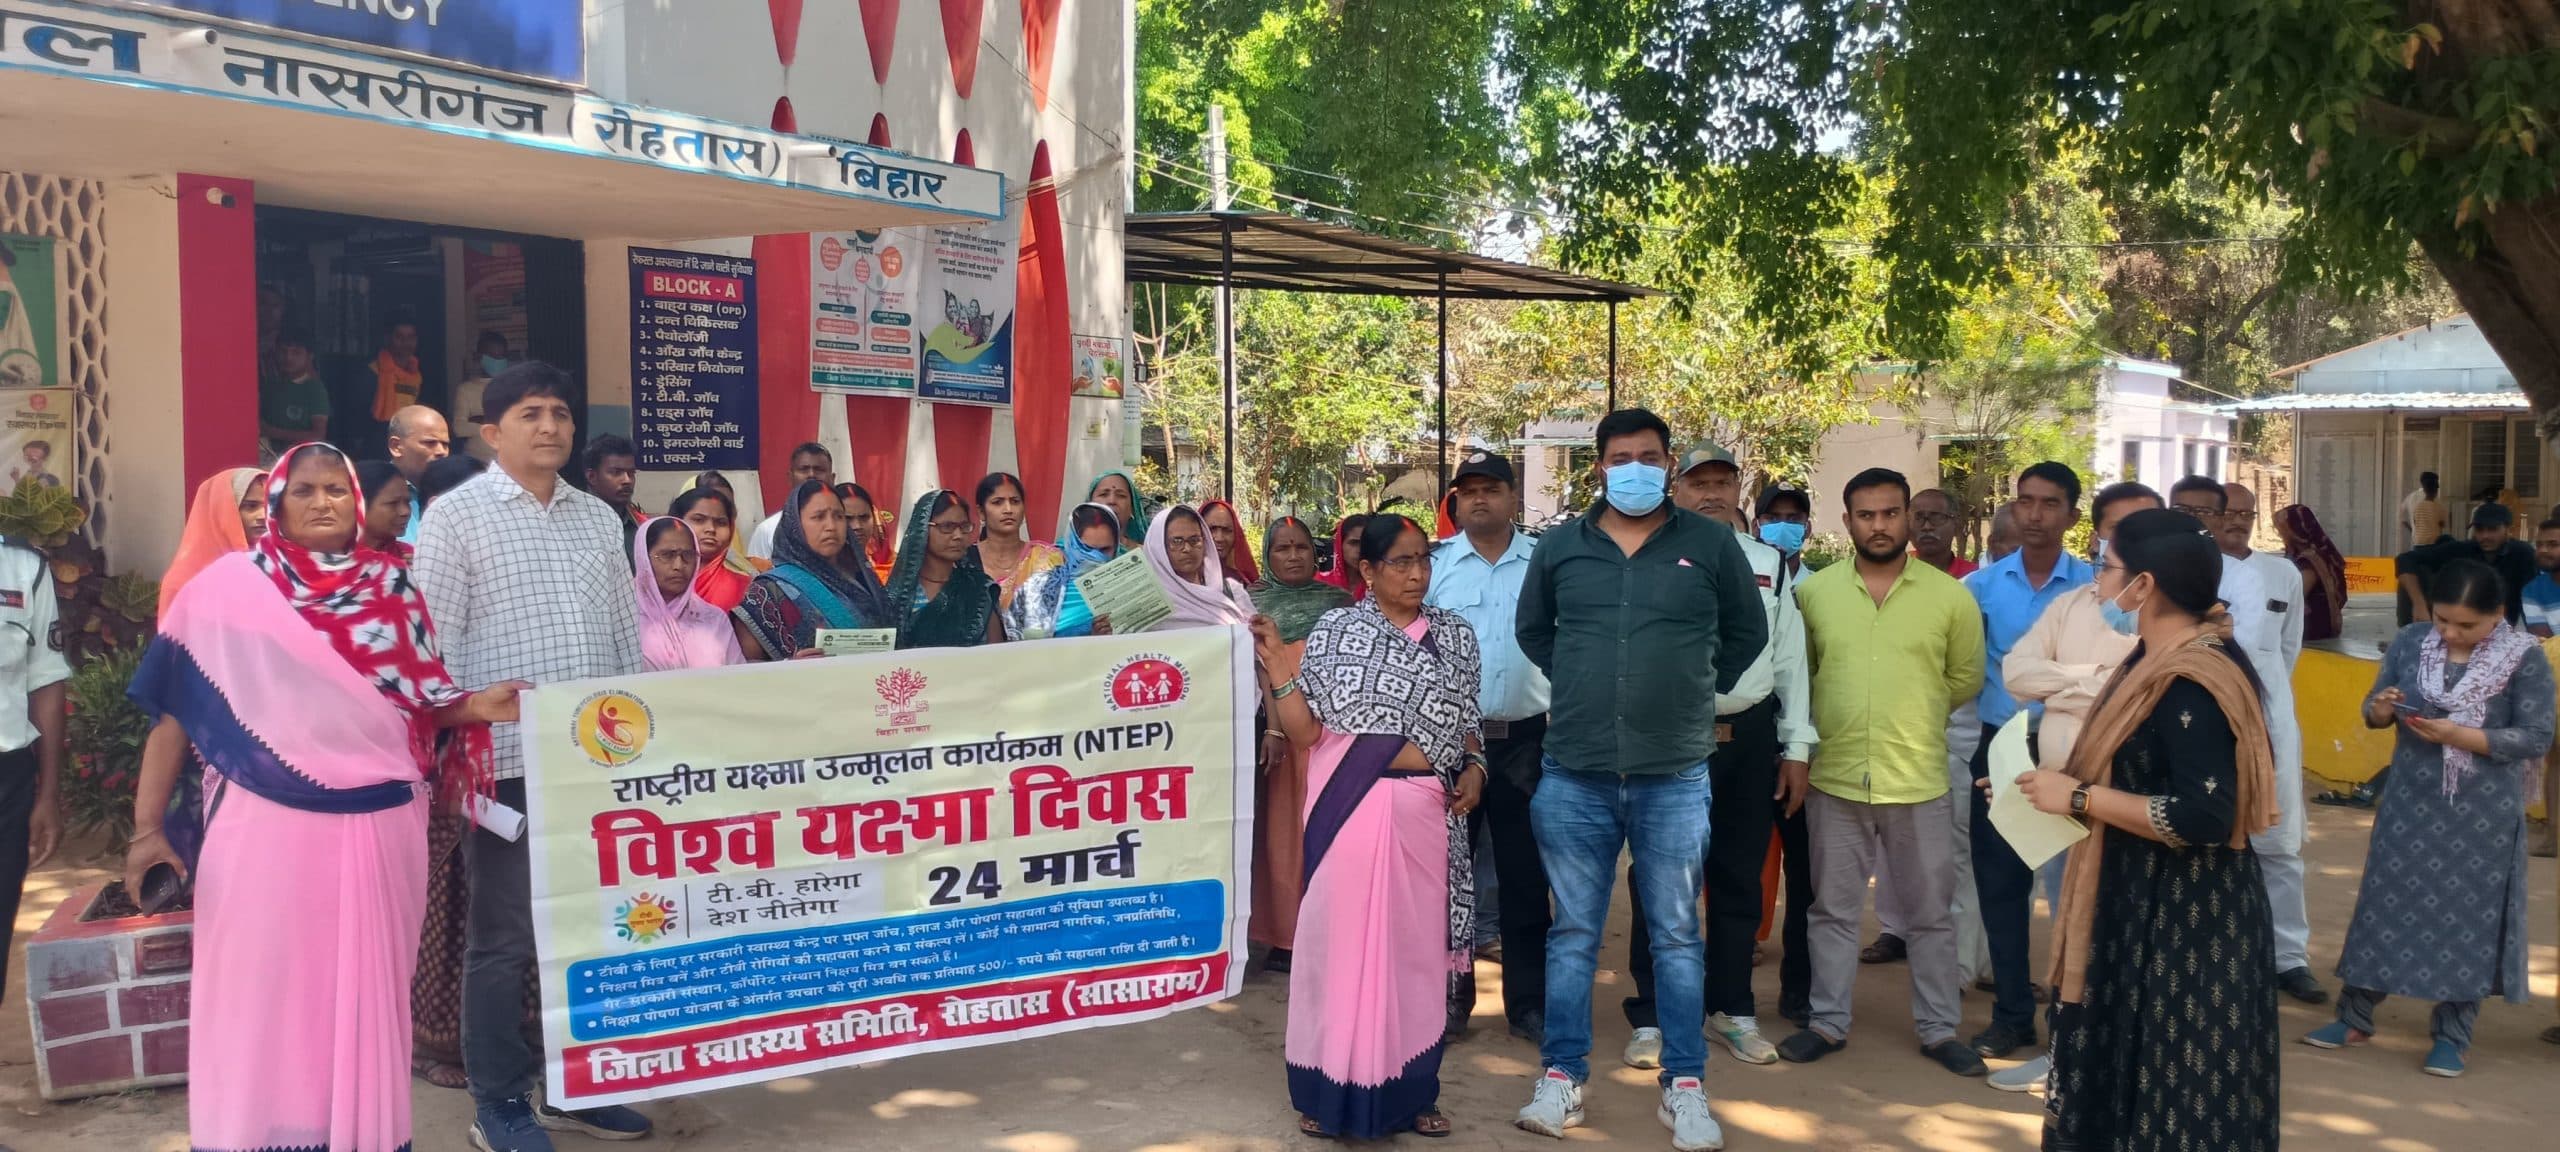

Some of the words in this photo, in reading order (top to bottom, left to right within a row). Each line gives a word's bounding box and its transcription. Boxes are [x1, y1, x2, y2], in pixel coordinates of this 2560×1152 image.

[222, 46, 548, 137] नासरीगंज
[836, 152, 947, 204] बिहार
[653, 276, 712, 296] BLOCK
[725, 283, 737, 298] A
[639, 300, 651, 309] 1.
[716, 302, 747, 319] (OPD)
[639, 315, 651, 324] 2.
[639, 331, 651, 340] 3.
[640, 346, 652, 355] 4.
[640, 362, 652, 370] 5.
[656, 359, 695, 373] परिवार
[698, 360, 745, 375] नियोजन
[640, 377, 652, 386] 6.
[640, 393, 652, 401] 7.
[641, 408, 652, 417] 8.
[641, 423, 652, 432] 9.
[642, 439, 659, 448] 10.
[643, 455, 659, 463] 11.
[1103, 663, 1124, 711] NATIONAL
[1126, 653, 1171, 663] HEALTH
[1174, 661, 1191, 701] MISSION
[611, 763, 717, 806] राष्ट्रीय
[725, 759, 806, 790] यक्ष्मा
[813, 747, 933, 785] उन्मूलन
[942, 732, 1064, 767] कार्यक्रम
[1073, 721, 1174, 761] (NTEP)
[591, 808, 781, 887] विश्व
[797, 787, 994, 860] यक्ष्मा
[1009, 764, 1194, 837] दिवस
[928, 860, 1002, 906] 24
[1020, 829, 1142, 886] मार्च
[795, 871, 862, 896] हारेगा
[707, 908, 750, 927] देश
[756, 898, 839, 921] जीतेगा
[598, 966, 628, 978] टीबी
[632, 960, 646, 973] के
[650, 957, 676, 971] लिए
[680, 954, 693, 965] हर
[699, 945, 744, 961] सरकारी
[822, 935, 838, 945] पर
[907, 922, 941, 936] इलाज
[944, 916, 967, 929] और
[1005, 907, 1046, 921] सहायता
[1050, 902, 1064, 914] की
[1067, 898, 1104, 913] सुविधा
[692, 966, 716, 979] और
[719, 960, 746, 975] टीबी
[750, 954, 791, 969] रोगियों
[792, 951, 812, 965] की
[815, 949, 859, 963] सहायता
[862, 943, 890, 957] करने
[893, 942, 912, 952] का
[914, 936, 952, 950] संकल्प
[976, 925, 1000, 939] कोई
[1003, 923, 1018, 935] भी
[1022, 920, 1059, 933] सामान्य
[643, 1006, 680, 1022] पोषण
[683, 1000, 724, 1015] योजना
[726, 995, 740, 1009] के
[742, 990, 782, 1005] अंतर्गत
[785, 986, 824, 999] उपचार
[826, 980, 845, 993] की
[847, 977, 867, 993] पूरी
[871, 973, 906, 987] अवधि
[909, 972, 931, 982] तक
[933, 964, 976, 979] प्रतिमाह
[1016, 952, 1043, 966] रुपये
[1047, 949, 1062, 962] की
[1066, 947, 1106, 960] सहायता
[1109, 942, 1134, 955] राशि
[1137, 940, 1149, 953] दी
[1152, 936, 1178, 950] जाती
[780, 970, 821, 983] संस्थान
[888, 958, 907, 968] बन
[910, 953, 939, 967] सकते
[587, 1045, 687, 1084] जिला
[692, 1024, 808, 1068] स्वास्थ्य
[812, 1003, 929, 1047] समिति,
[939, 989, 1052, 1027] रोहतास
[1061, 963, 1211, 1017] (सासाराम)
